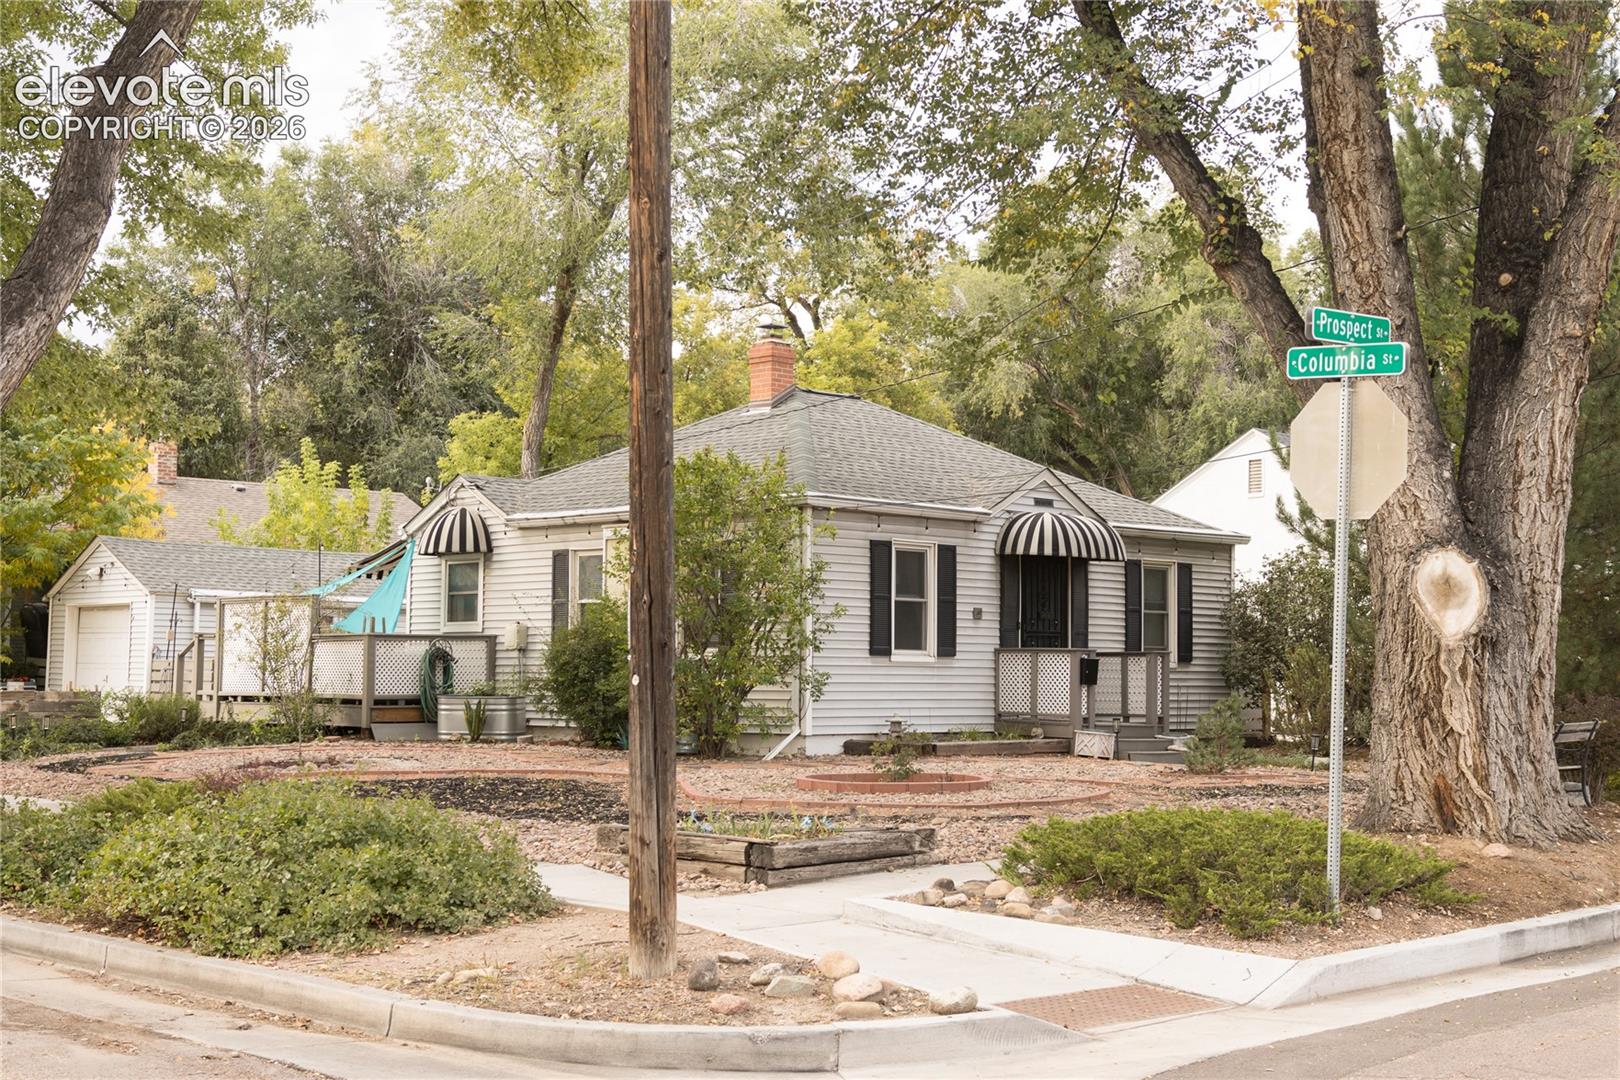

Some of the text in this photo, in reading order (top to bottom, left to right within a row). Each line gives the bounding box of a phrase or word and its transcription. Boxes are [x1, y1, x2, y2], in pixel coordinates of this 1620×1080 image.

[1319, 312, 1373, 339] Prospect
[1297, 350, 1393, 373] Columbia St
